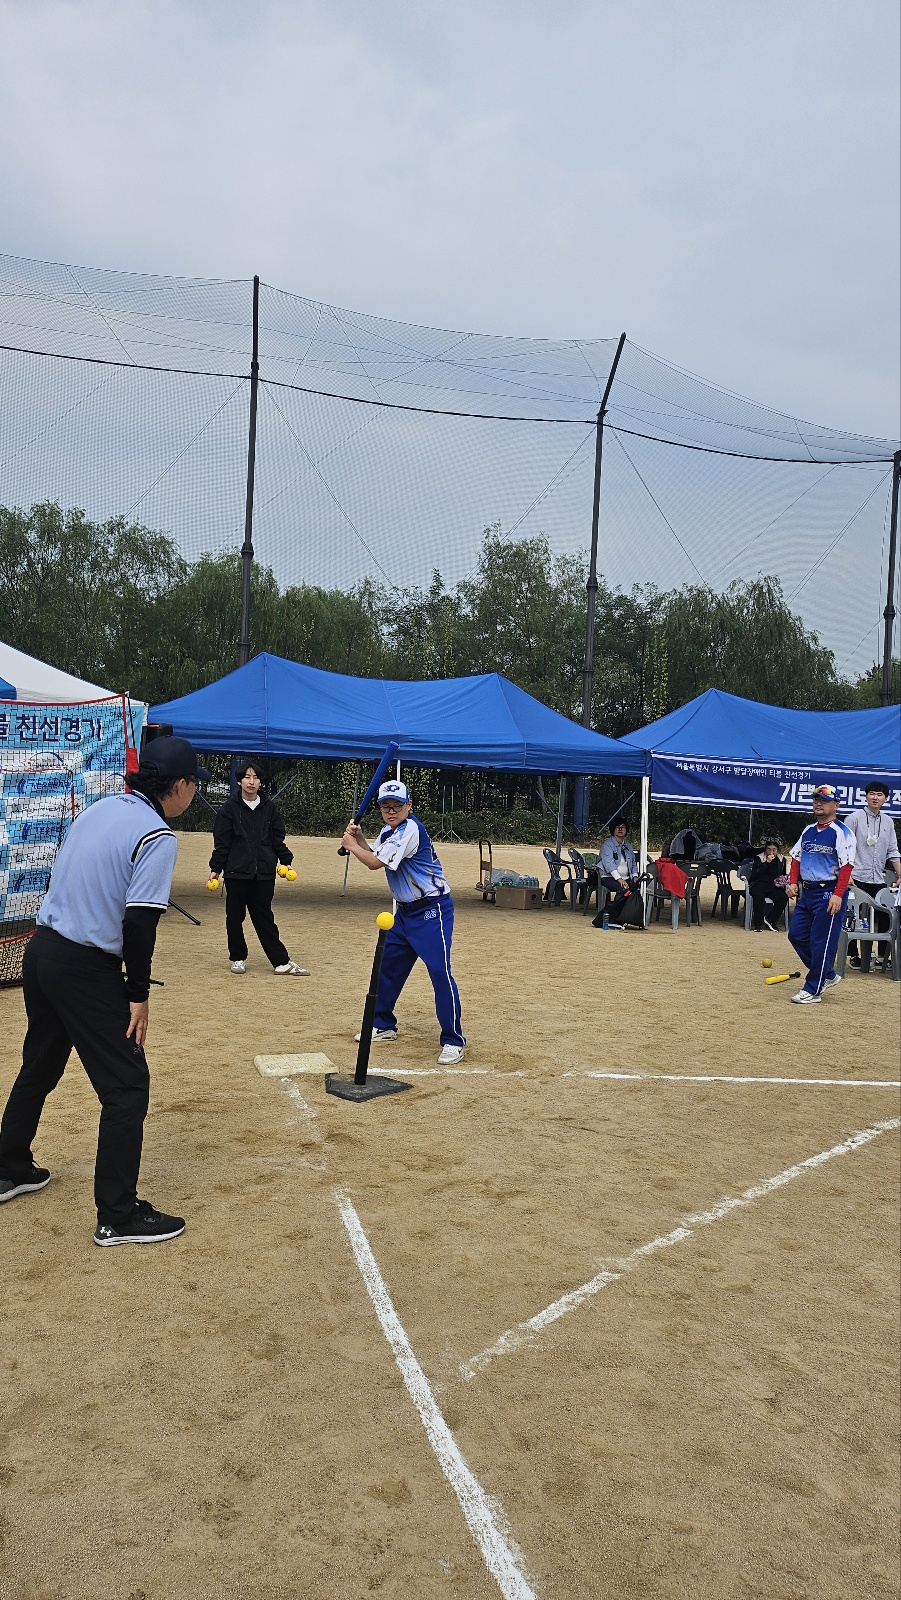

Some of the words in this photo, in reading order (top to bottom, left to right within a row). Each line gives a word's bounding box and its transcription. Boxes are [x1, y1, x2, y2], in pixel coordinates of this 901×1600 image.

[16, 714, 102, 742] 친선경기
[675, 762, 710, 773] 서울특별시
[711, 765, 732, 775] 강서구
[733, 767, 767, 778] 발달장애인
[769, 769, 782, 779] 티볼
[784, 770, 811, 780] 친선경기
